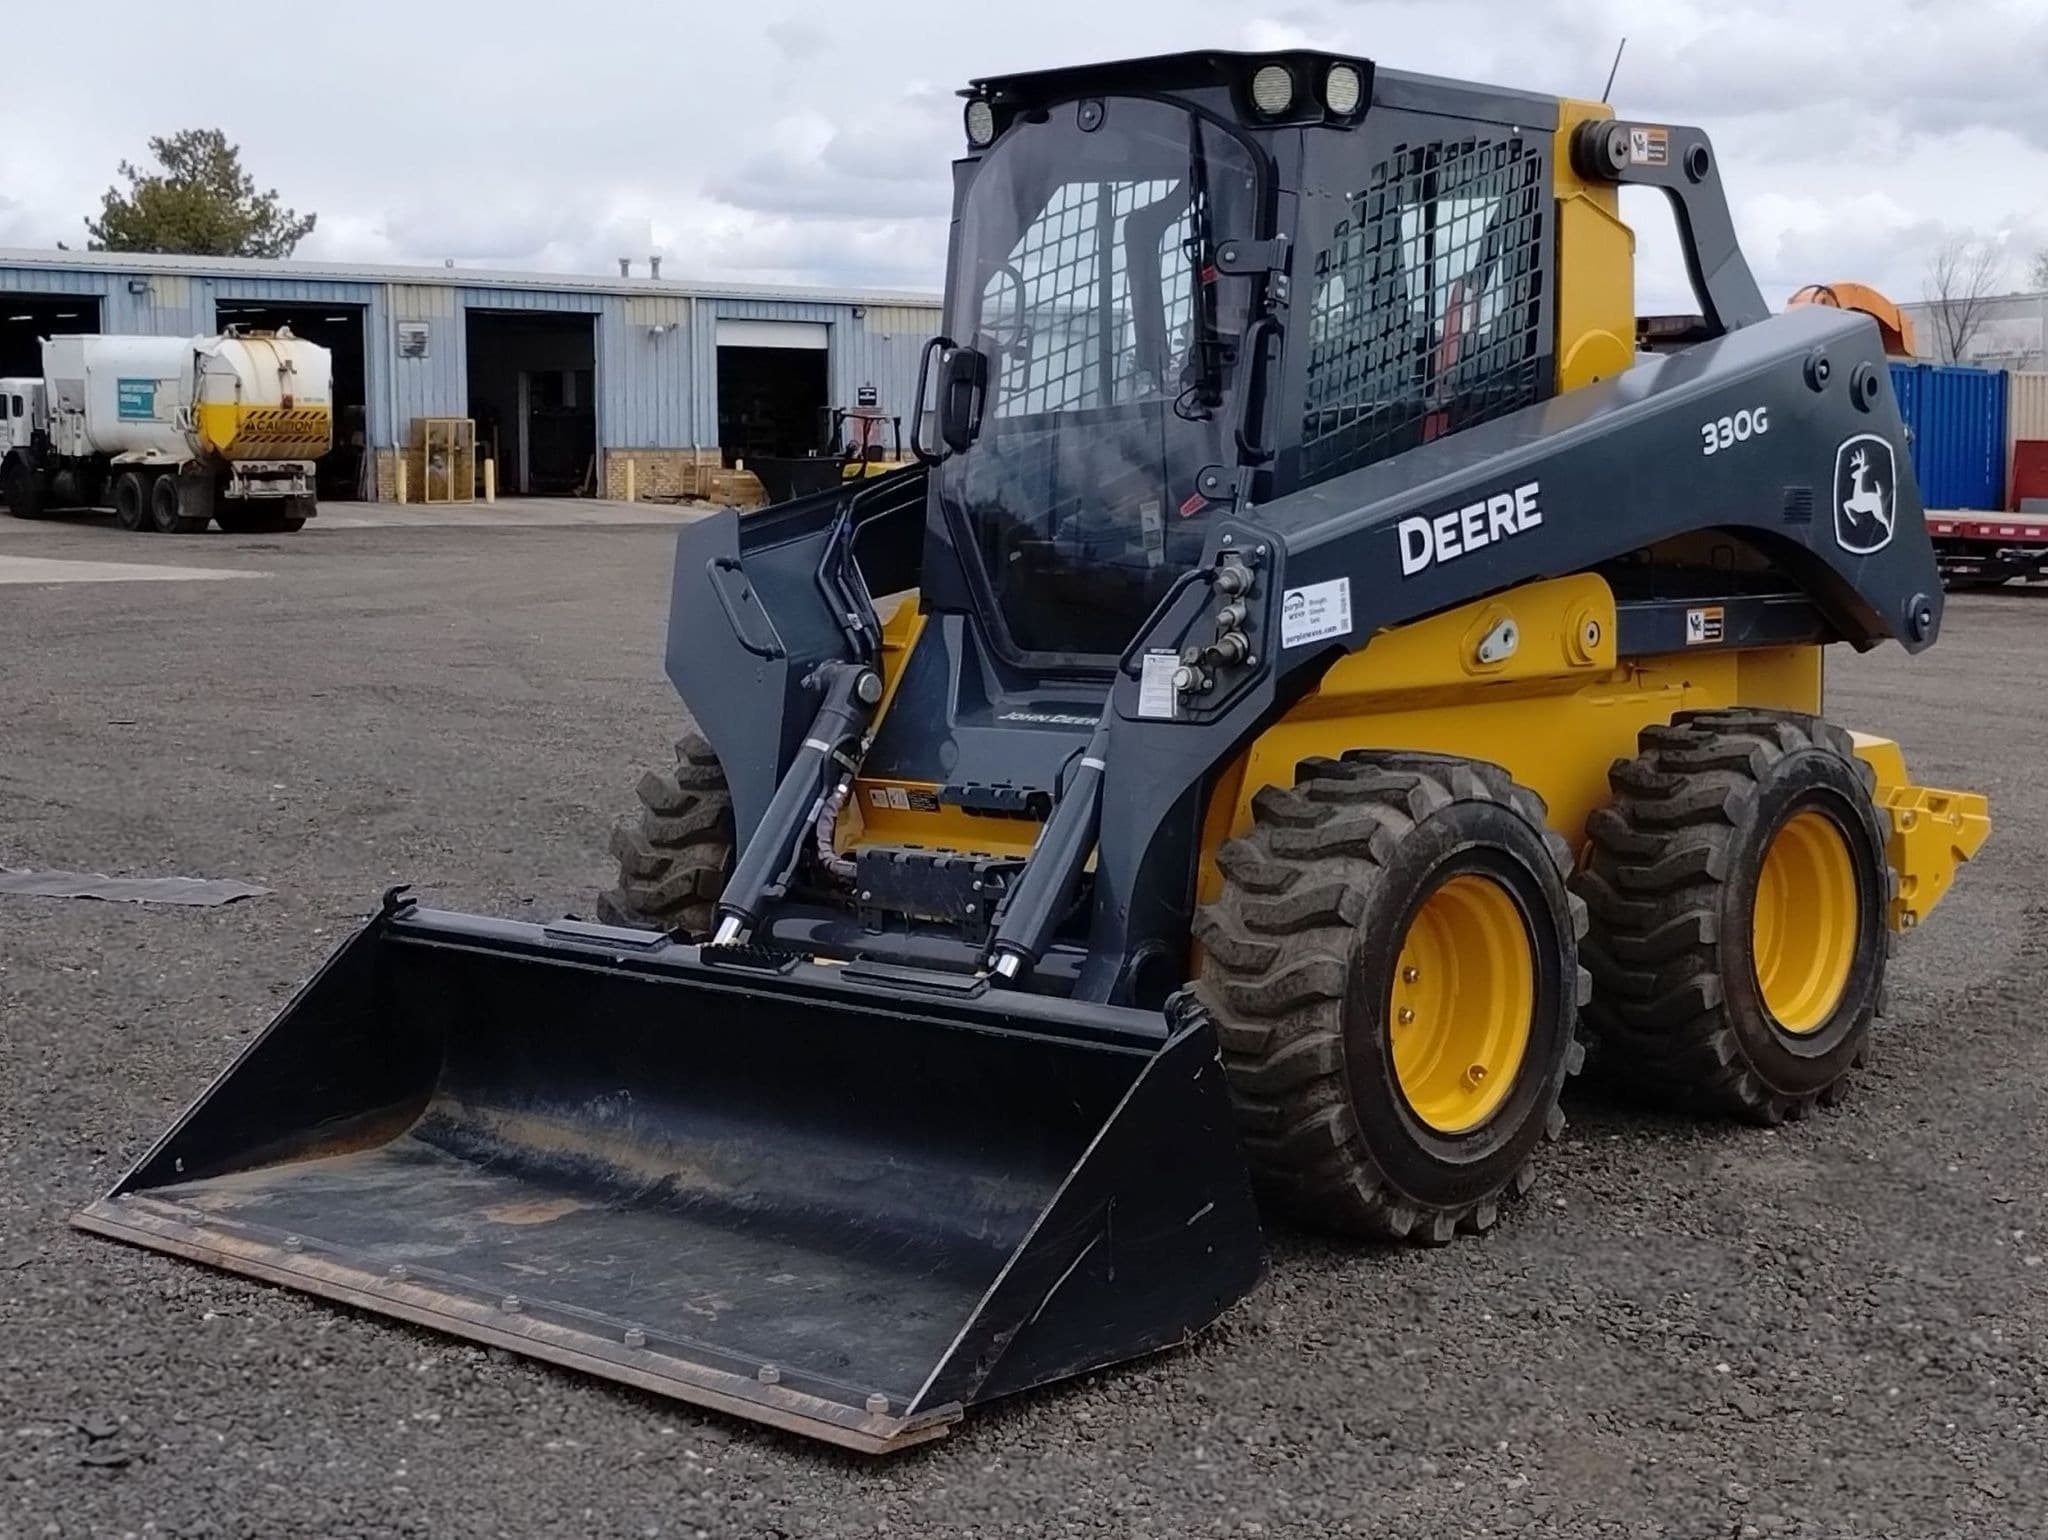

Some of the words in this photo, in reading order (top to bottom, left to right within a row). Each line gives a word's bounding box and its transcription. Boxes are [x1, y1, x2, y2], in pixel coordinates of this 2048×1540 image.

[257, 421, 314, 433] CAION
[1701, 407, 1768, 455] 330G
[1398, 481, 1543, 576] DEERE
[998, 711, 1049, 721] JOHN
[1050, 714, 1100, 726] DEER
